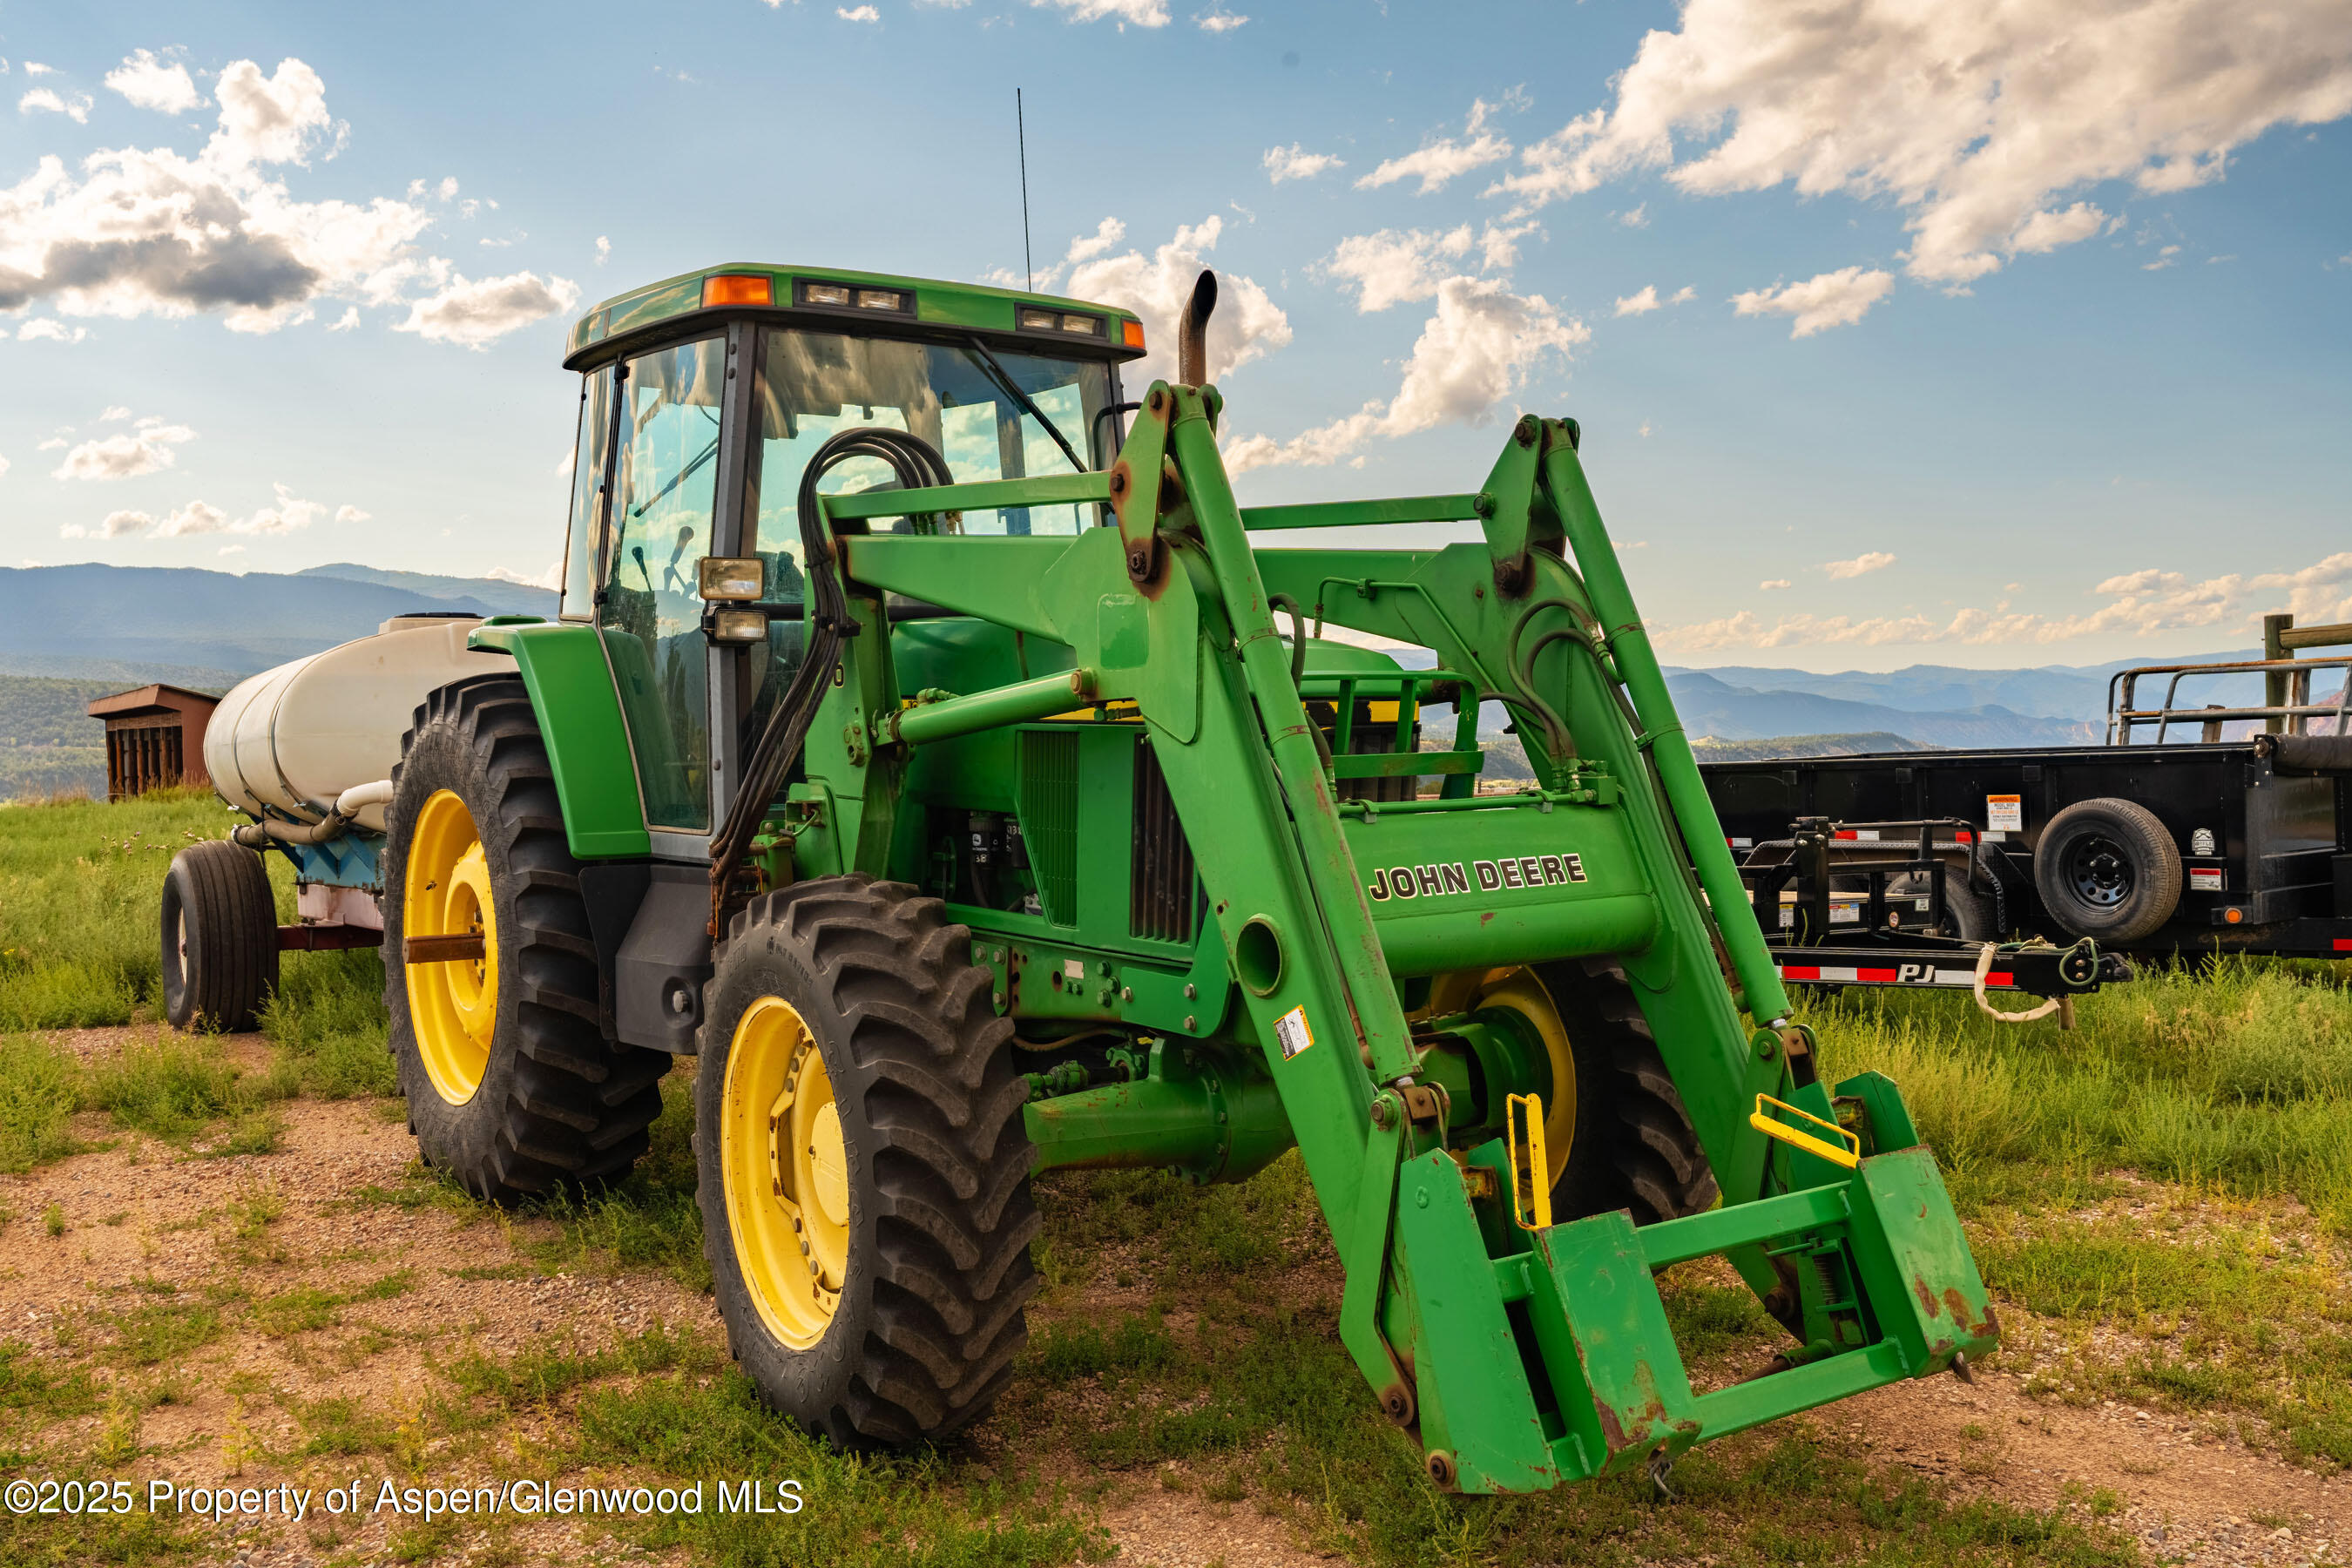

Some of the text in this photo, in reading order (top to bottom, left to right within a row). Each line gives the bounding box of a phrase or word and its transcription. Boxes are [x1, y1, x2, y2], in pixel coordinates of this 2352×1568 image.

[1369, 853, 1588, 902] JOHN DEERE
[1896, 963, 1935, 983] PJ
